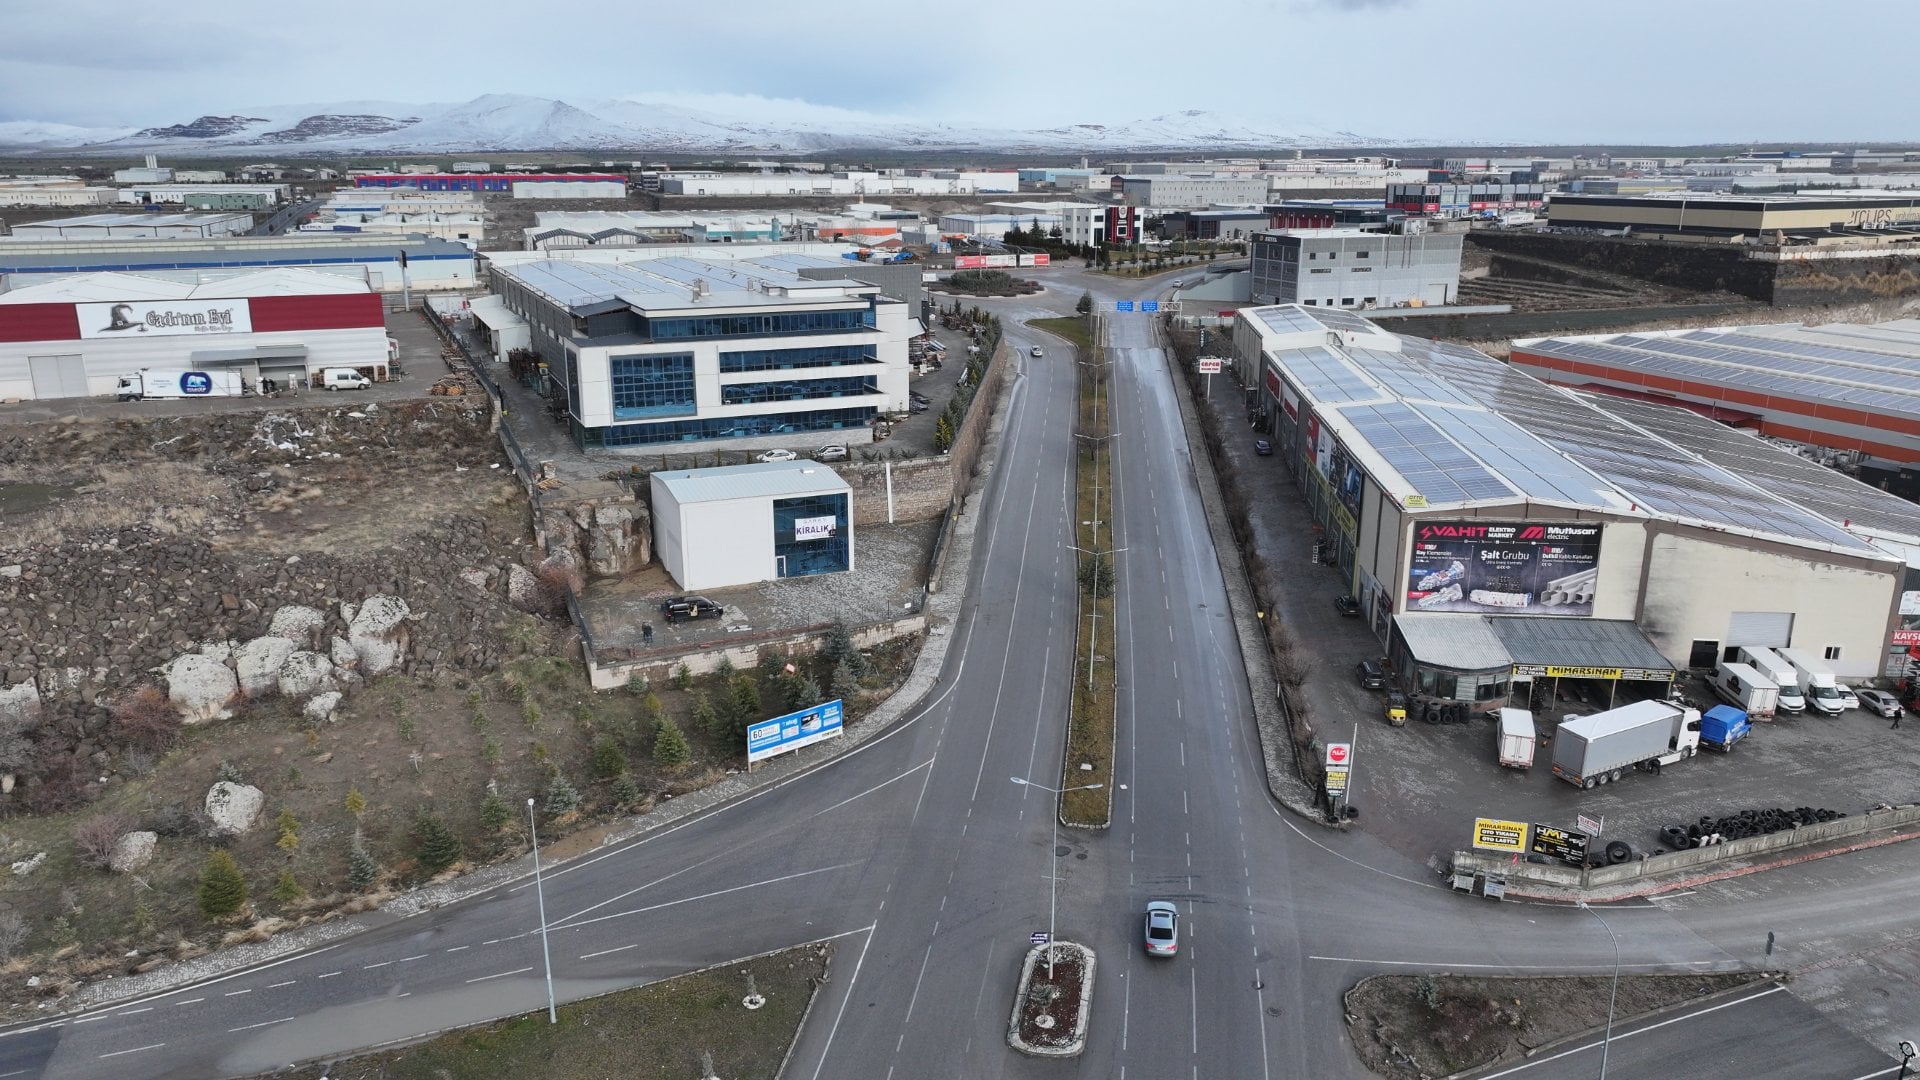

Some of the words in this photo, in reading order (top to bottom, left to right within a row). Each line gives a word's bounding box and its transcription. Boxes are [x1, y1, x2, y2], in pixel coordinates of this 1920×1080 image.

[1481, 550, 1500, 561] Şalt
[1502, 550, 1530, 560] Grubu
[753, 729, 763, 739] 60
